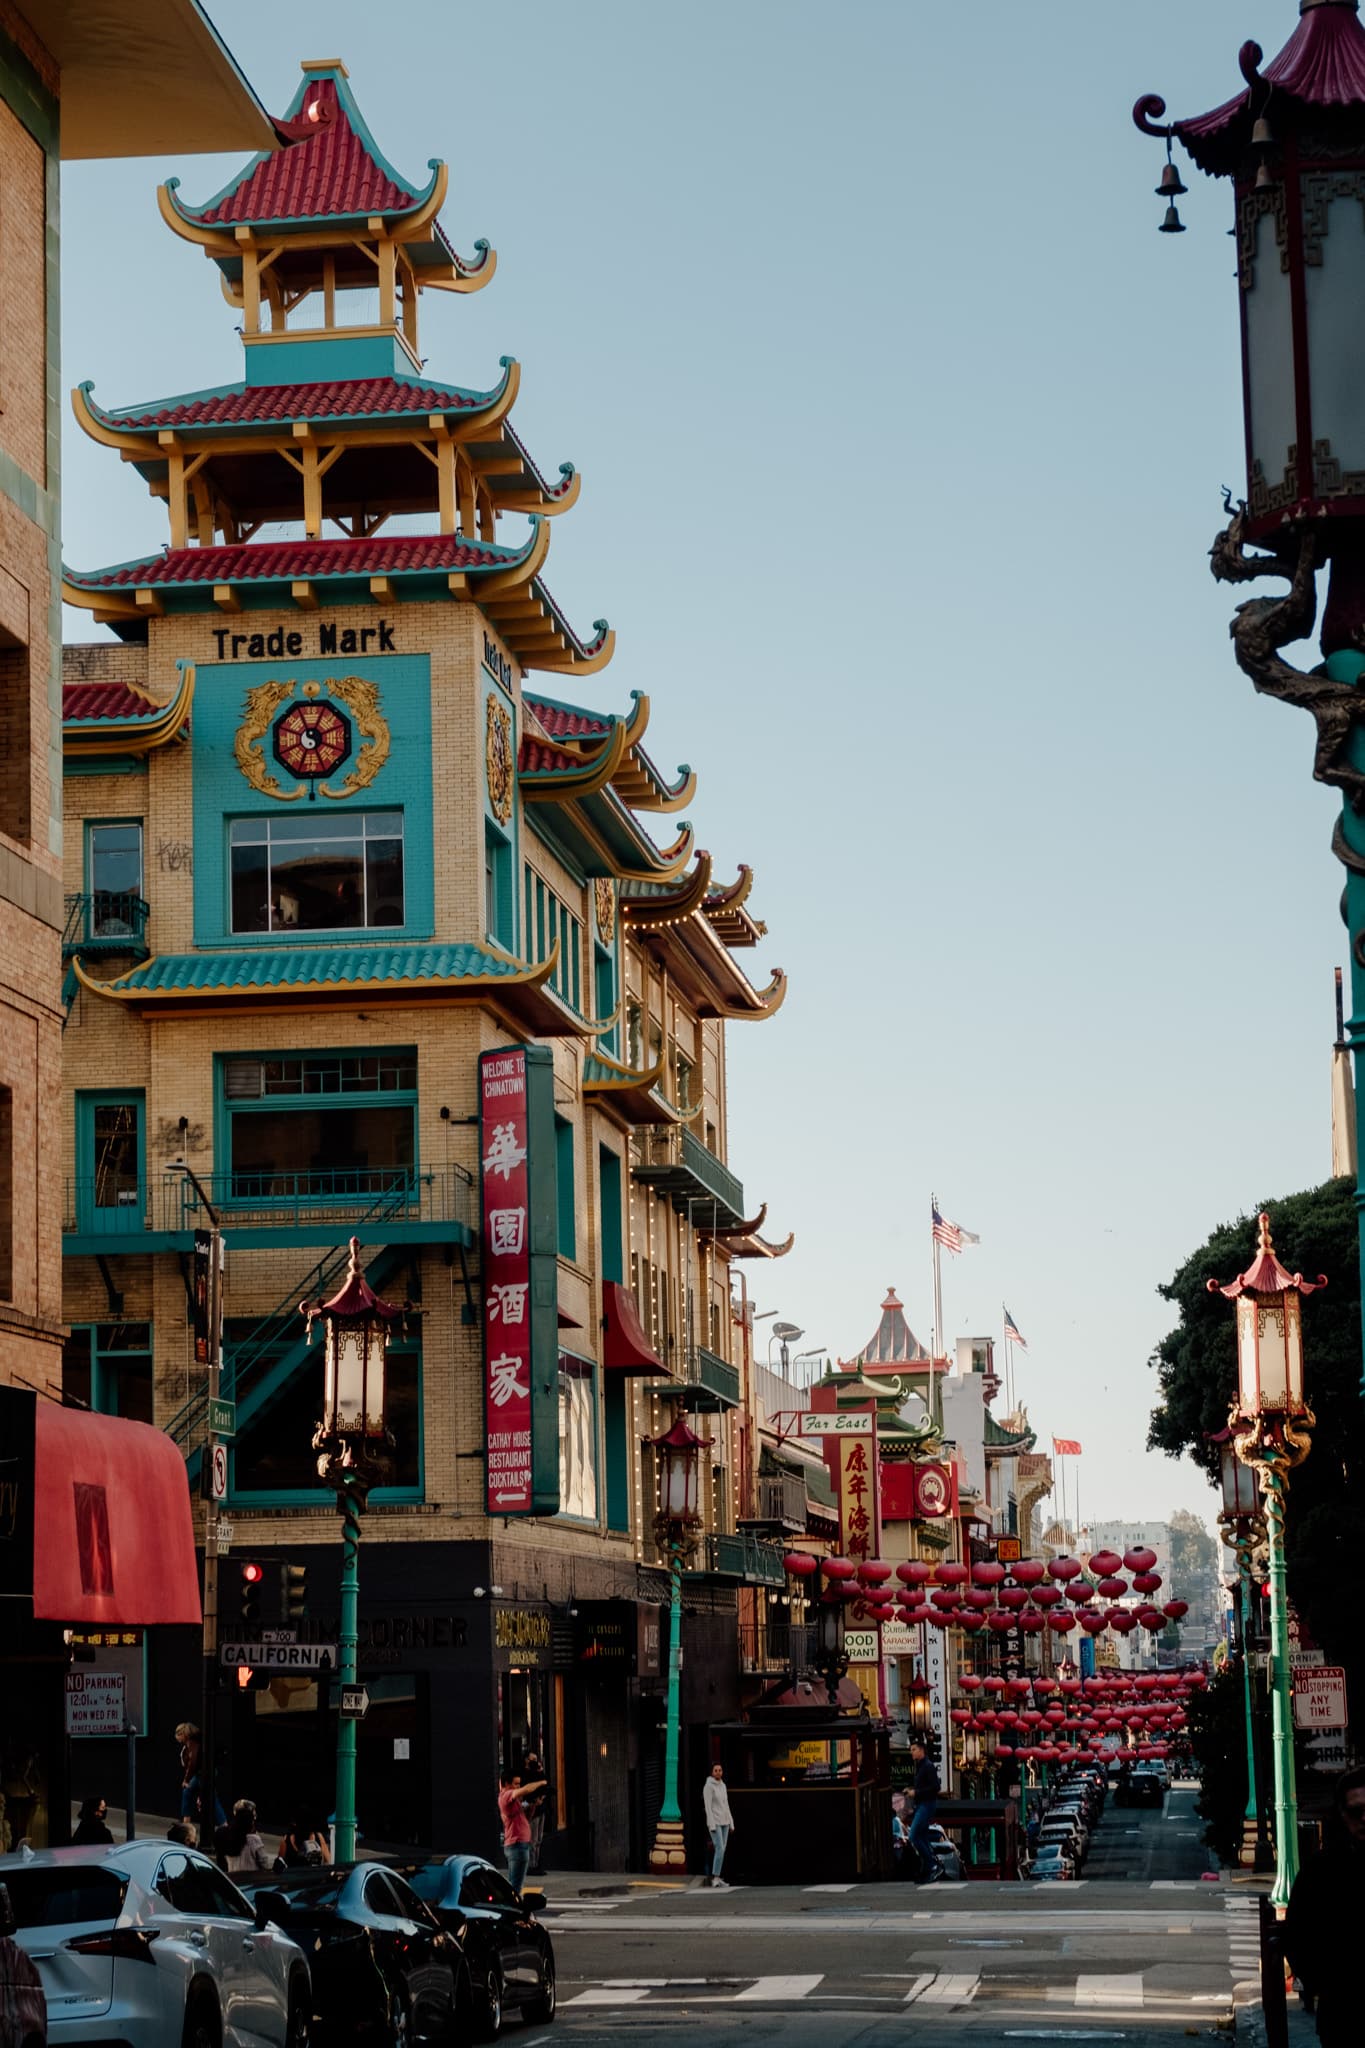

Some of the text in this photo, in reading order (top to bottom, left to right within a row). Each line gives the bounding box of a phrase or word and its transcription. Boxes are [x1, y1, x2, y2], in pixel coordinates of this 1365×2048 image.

[212, 620, 396, 659] Trade Mark
[482, 1057, 525, 1079] WELCOME TO
[485, 1077, 524, 1097] CHINATOWN
[214, 1407, 231, 1427] Grant
[805, 1415, 868, 1430] Far East
[488, 1431, 531, 1449] CATHAY HOUSE
[488, 1451, 531, 1468] RESTAURANT
[488, 1472, 524, 1488] COCKTAILS
[275, 1633, 291, 1641] 700
[845, 1635, 873, 1646] OOD
[225, 1647, 331, 1664] CALIFORNIA
[66, 1674, 122, 1690] NO PARKING
[1295, 1680, 1342, 1693] NO STOPPING
[1310, 1696, 1329, 1705] ANY
[72, 1710, 118, 1720] MON WED FRI
[1310, 1707, 1332, 1716] TIME
